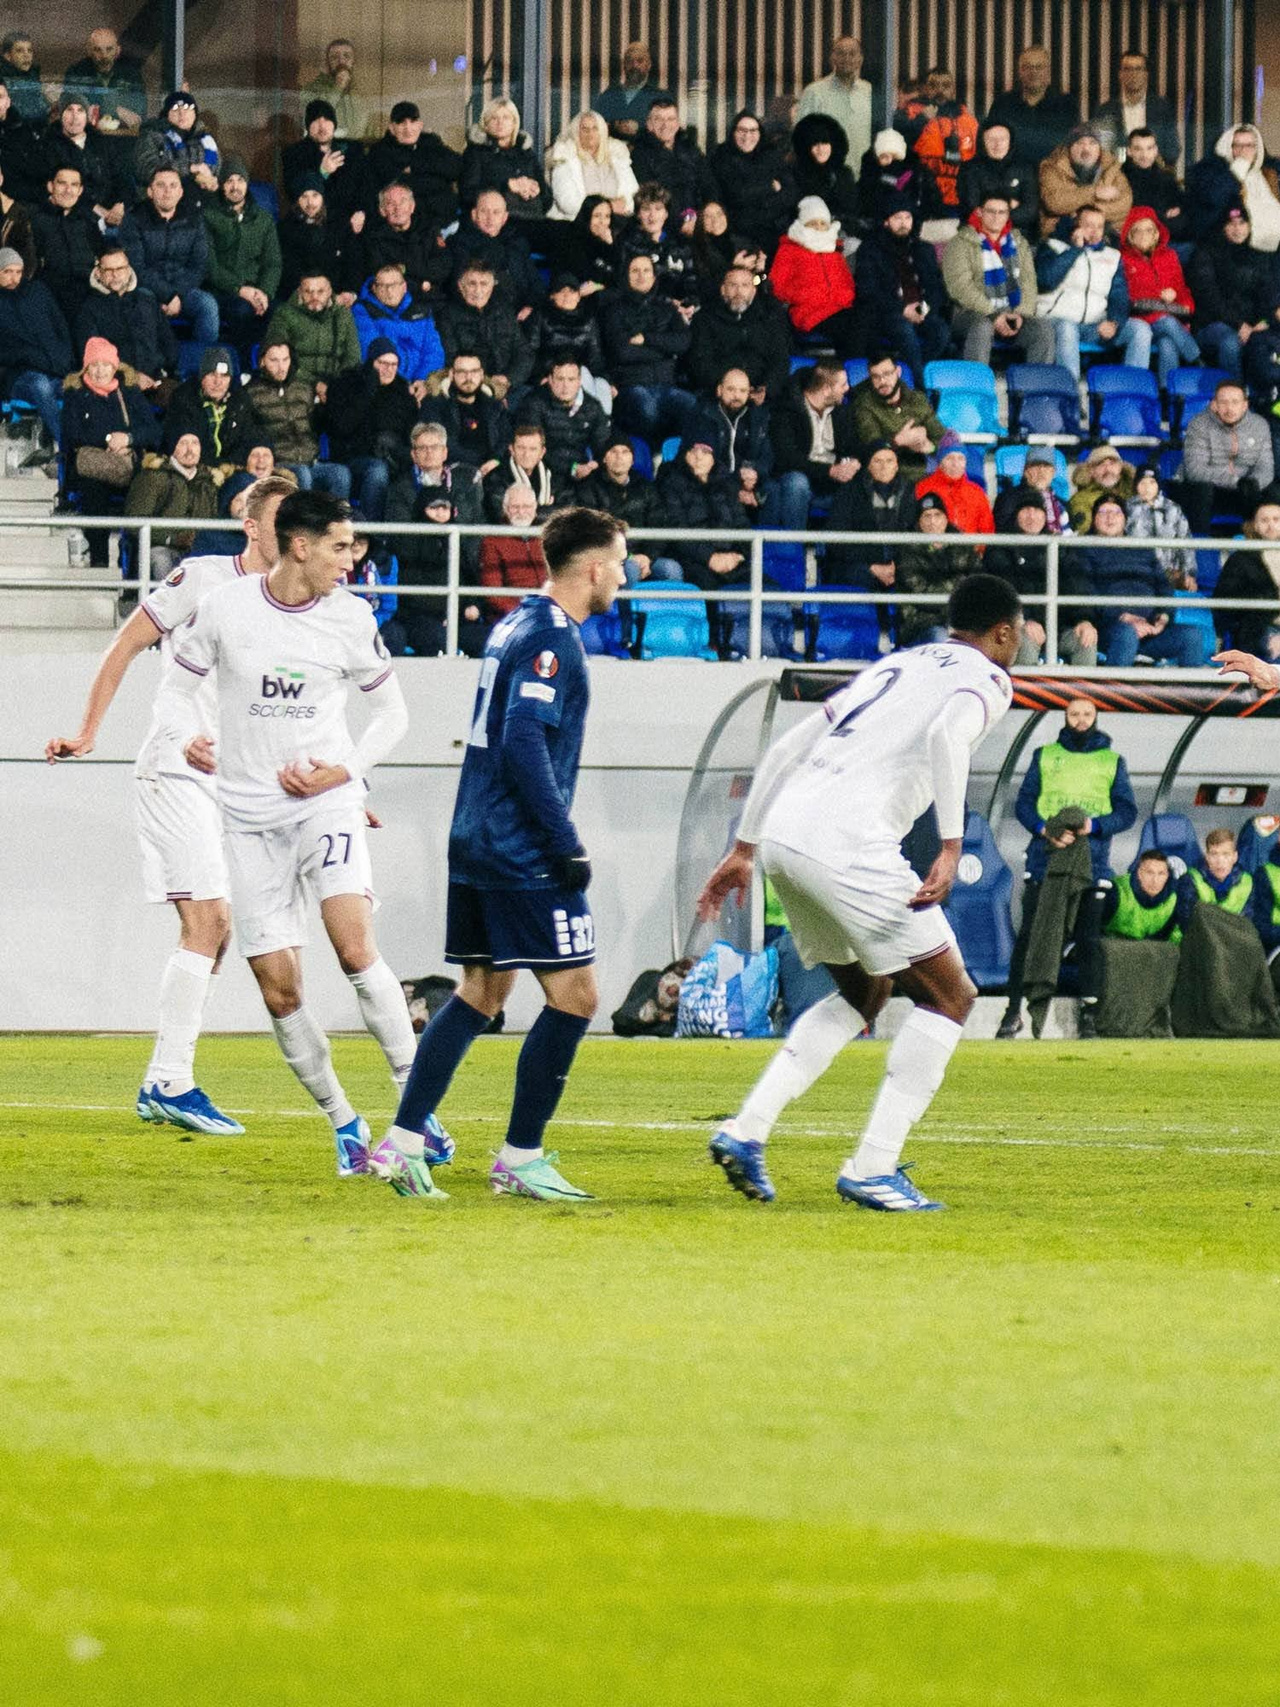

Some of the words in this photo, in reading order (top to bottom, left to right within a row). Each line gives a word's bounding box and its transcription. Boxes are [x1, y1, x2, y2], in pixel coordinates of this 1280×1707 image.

[261, 674, 306, 700] bw
[828, 666, 903, 738] 2
[248, 702, 318, 719] SCORES
[317, 832, 352, 868] 27
